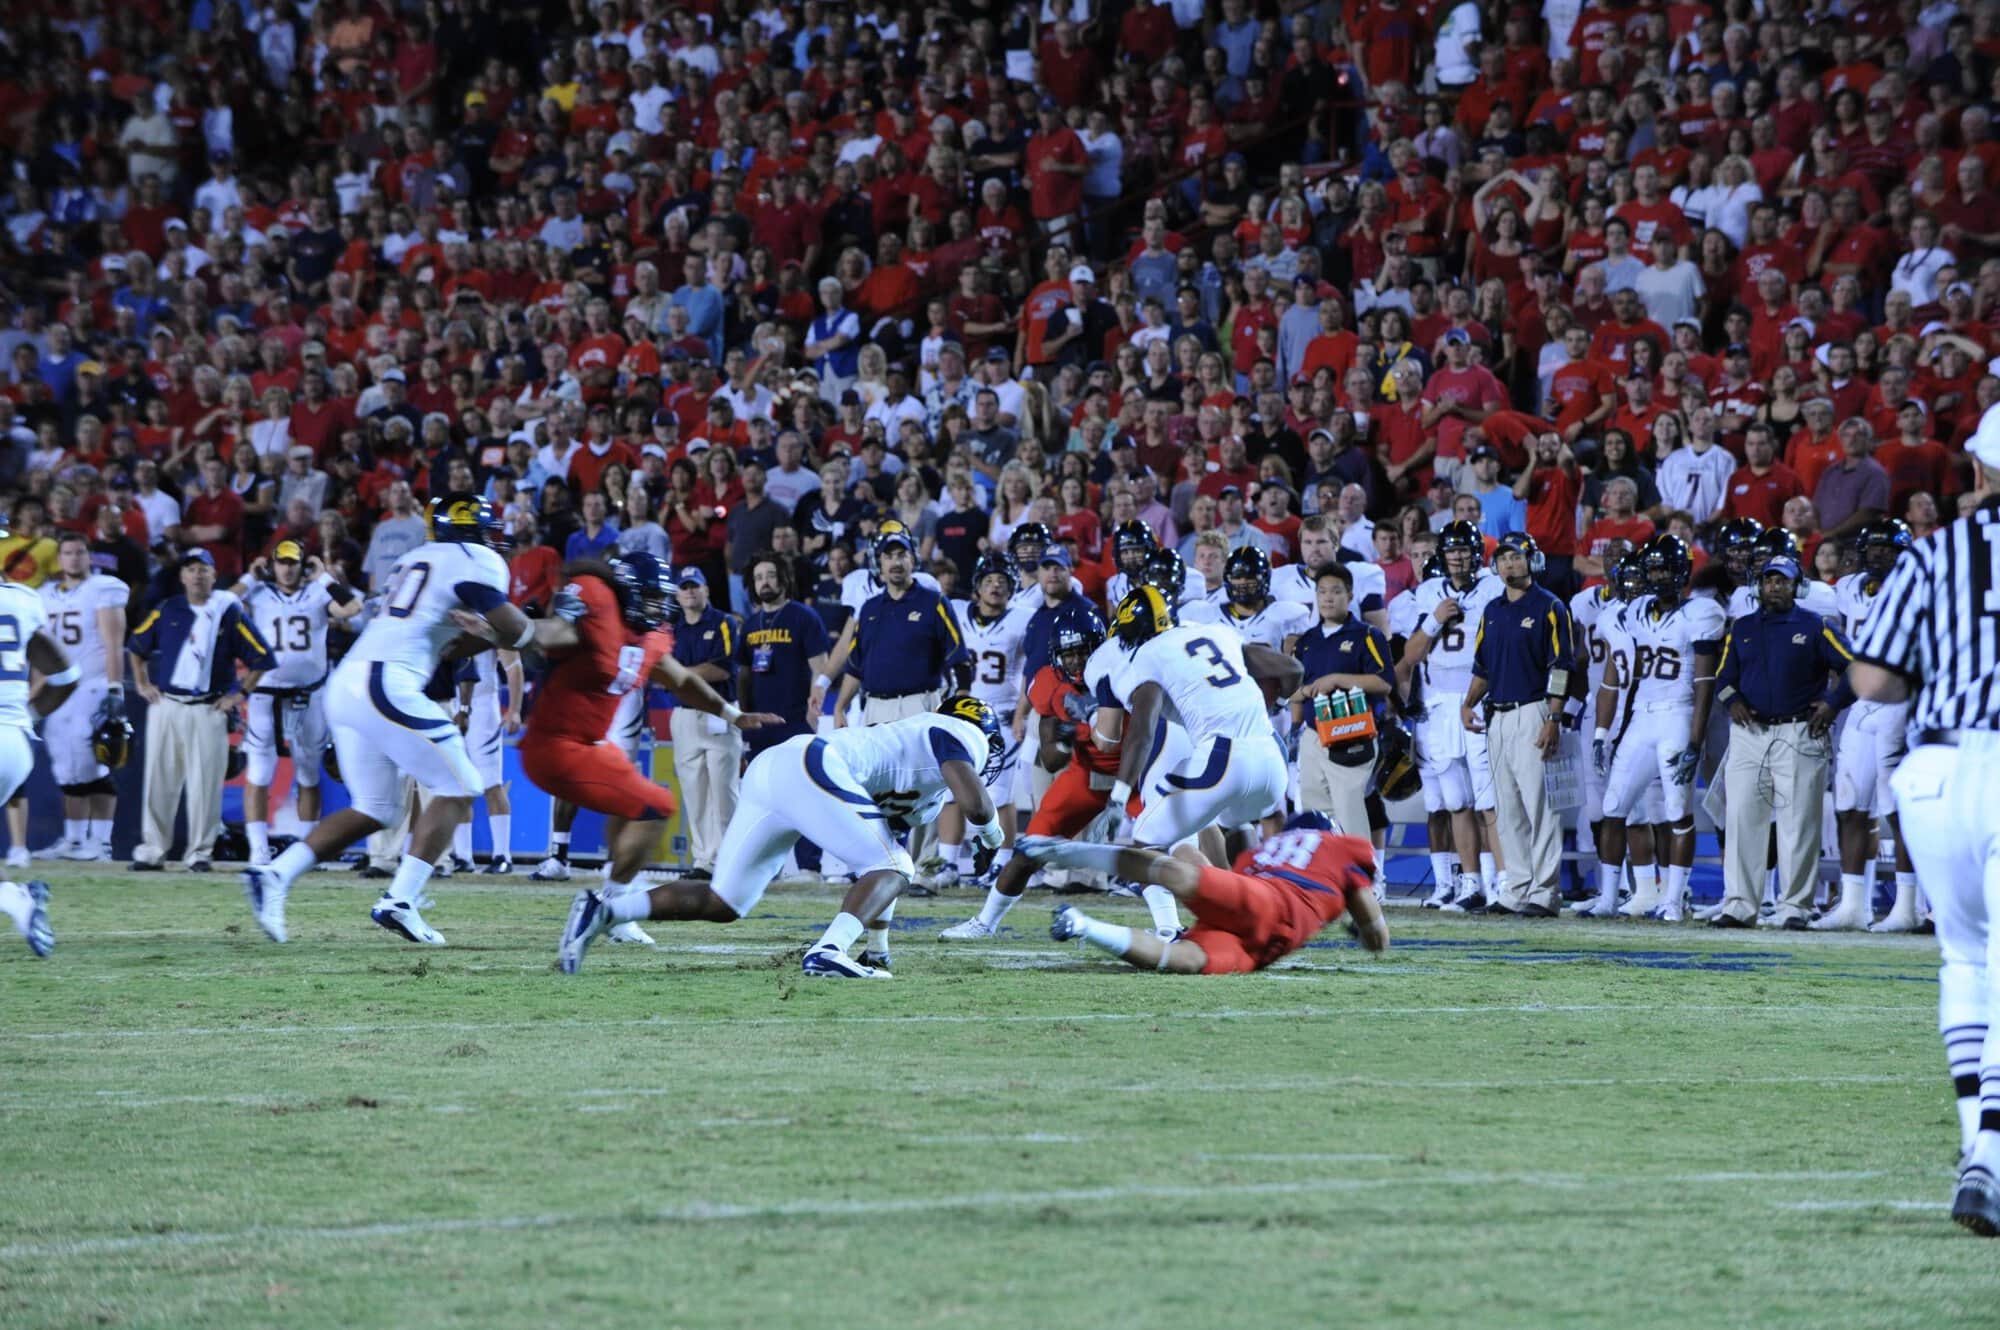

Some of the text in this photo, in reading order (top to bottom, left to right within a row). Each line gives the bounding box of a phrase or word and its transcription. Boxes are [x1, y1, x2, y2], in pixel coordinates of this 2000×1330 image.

[1686, 473, 1701, 509] 7
[273, 616, 311, 651] 13
[1185, 637, 1242, 689] 3
